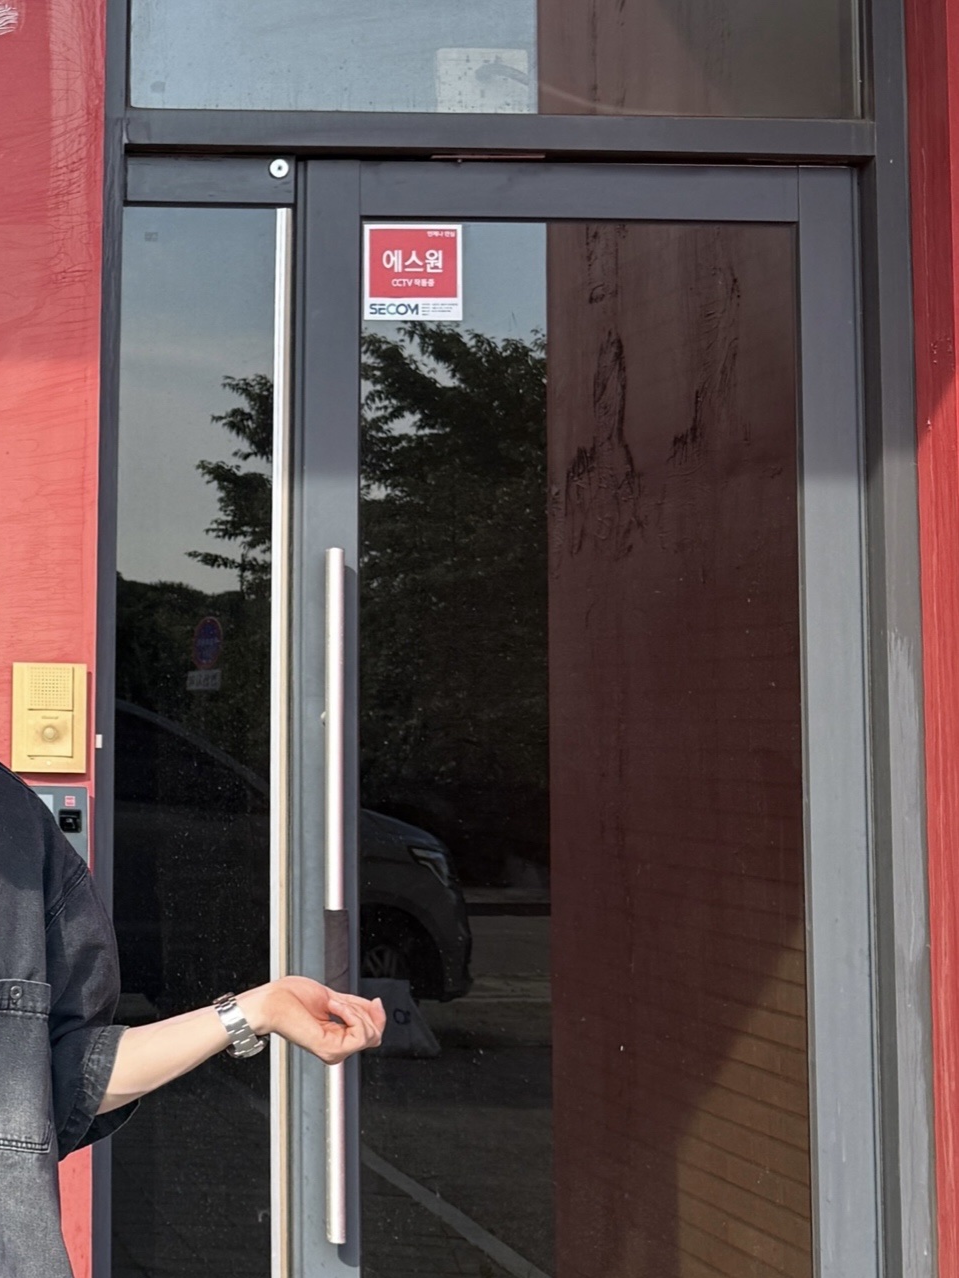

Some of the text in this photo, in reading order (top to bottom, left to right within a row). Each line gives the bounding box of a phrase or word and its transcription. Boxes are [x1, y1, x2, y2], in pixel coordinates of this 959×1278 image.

[382, 249, 444, 273] 에스원
[414, 279, 434, 287] 작동중
[369, 303, 419, 316] SECOM
